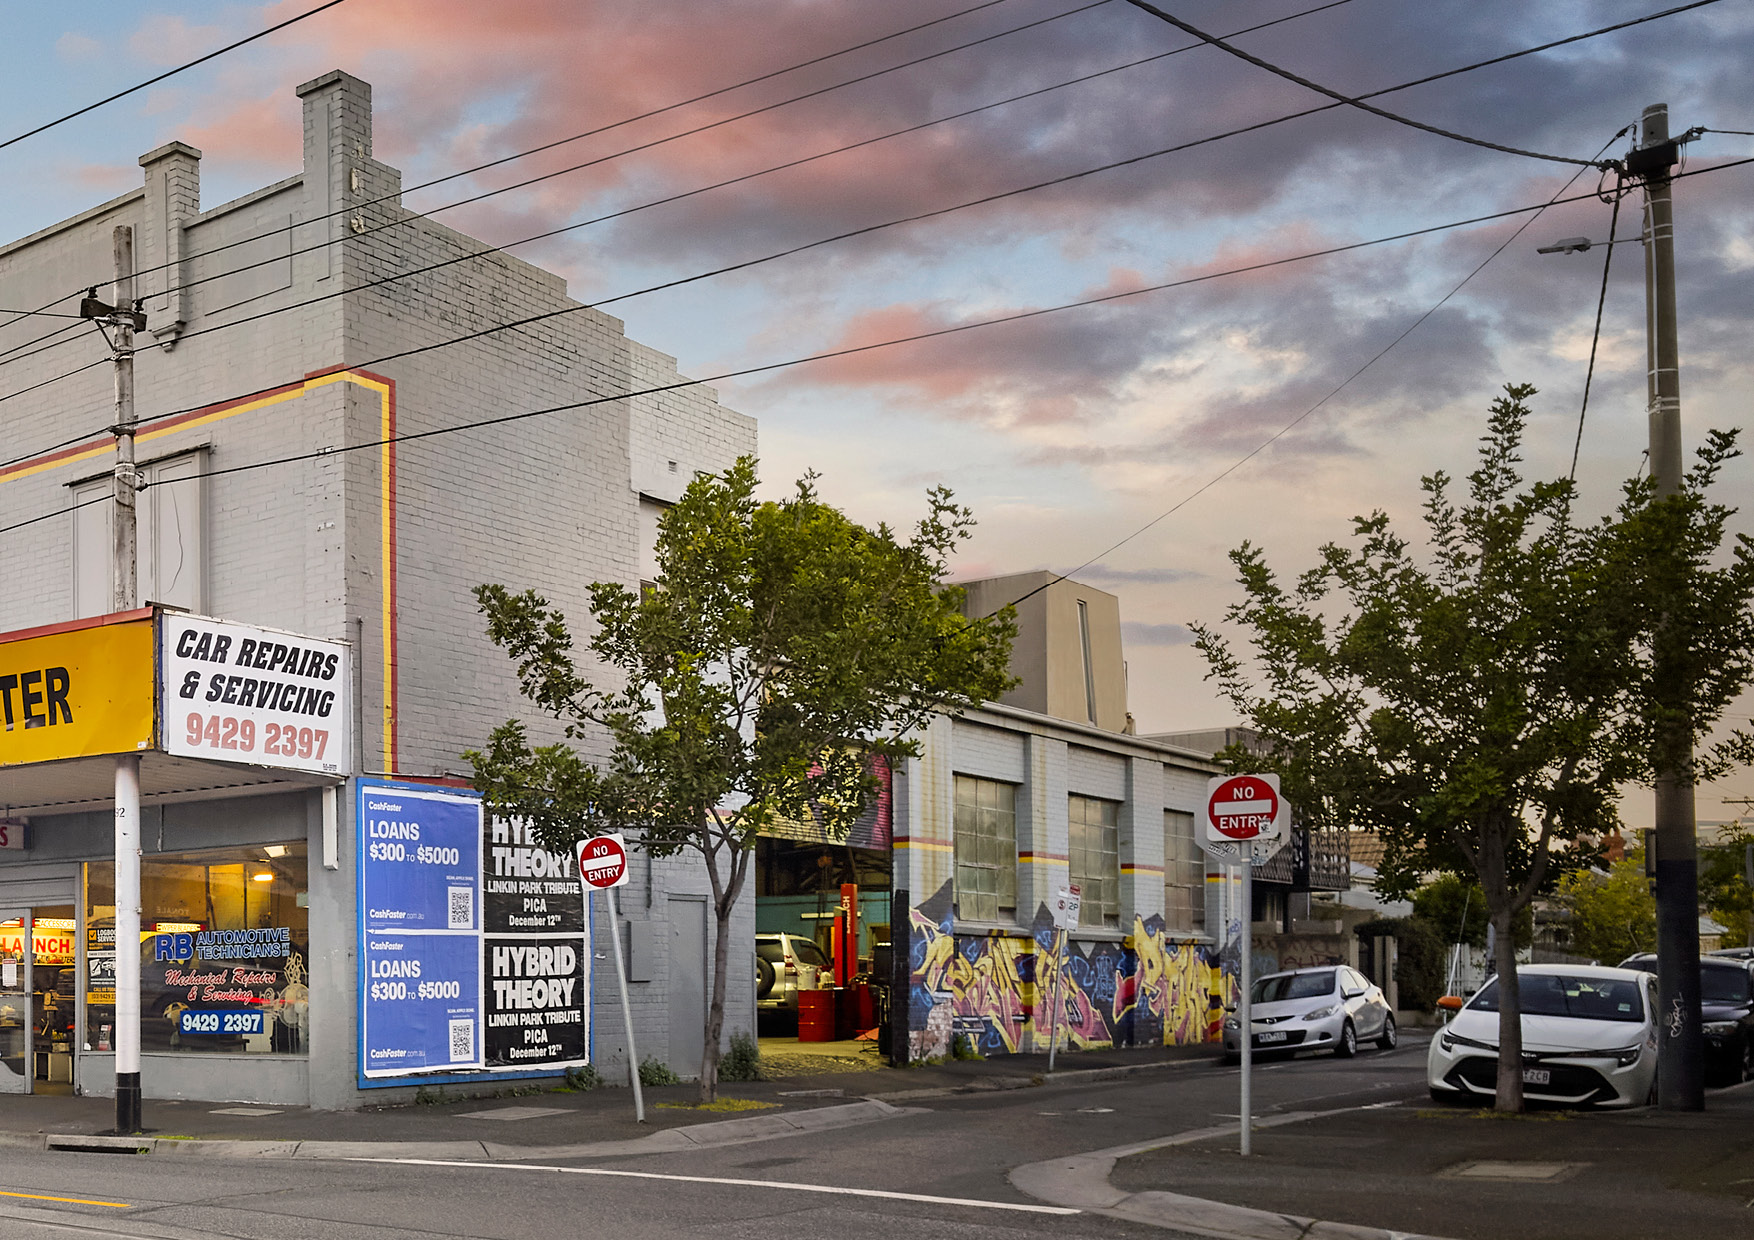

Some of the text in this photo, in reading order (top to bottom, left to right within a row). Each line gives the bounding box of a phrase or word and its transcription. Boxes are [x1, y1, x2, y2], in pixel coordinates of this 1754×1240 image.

[176, 629, 339, 680] CAR REPAIRS
[0, 667, 73, 732] TER
[180, 671, 336, 717] & SERVICING
[186, 712, 329, 760] 9429 2397
[1233, 786, 1255, 800] NO
[369, 801, 402, 812] CashFaster
[369, 819, 420, 841] LOANS
[369, 841, 459, 865] $300 TO $5000
[593, 845, 608, 857] NO
[492, 847, 573, 878] THEORY
[588, 866, 619, 881] ENTRY
[488, 880, 581, 894] LINKIN PARK TRIBUTE
[523, 898, 547, 913] PICA
[509, 915, 561, 926] December 12TH
[155, 927, 290, 961] RB AUTOMOTIVE
[196, 943, 281, 960] TECHNICIANS
[370, 941, 403, 951] CashFaster
[371, 959, 422, 978] LOANS
[493, 946, 576, 977] HYBRID
[165, 966, 277, 988] Mechanical Repairs
[188, 985, 253, 1005] & Servicing
[371, 981, 460, 1002] $300 TO $5000
[493, 978, 576, 1010] THEORY
[182, 1014, 261, 1032] 9429 2397
[489, 1010, 581, 1027] LINKIN PARK TRIBUTE
[524, 1029, 548, 1044] PICA
[510, 1044, 562, 1058] December 12TH
